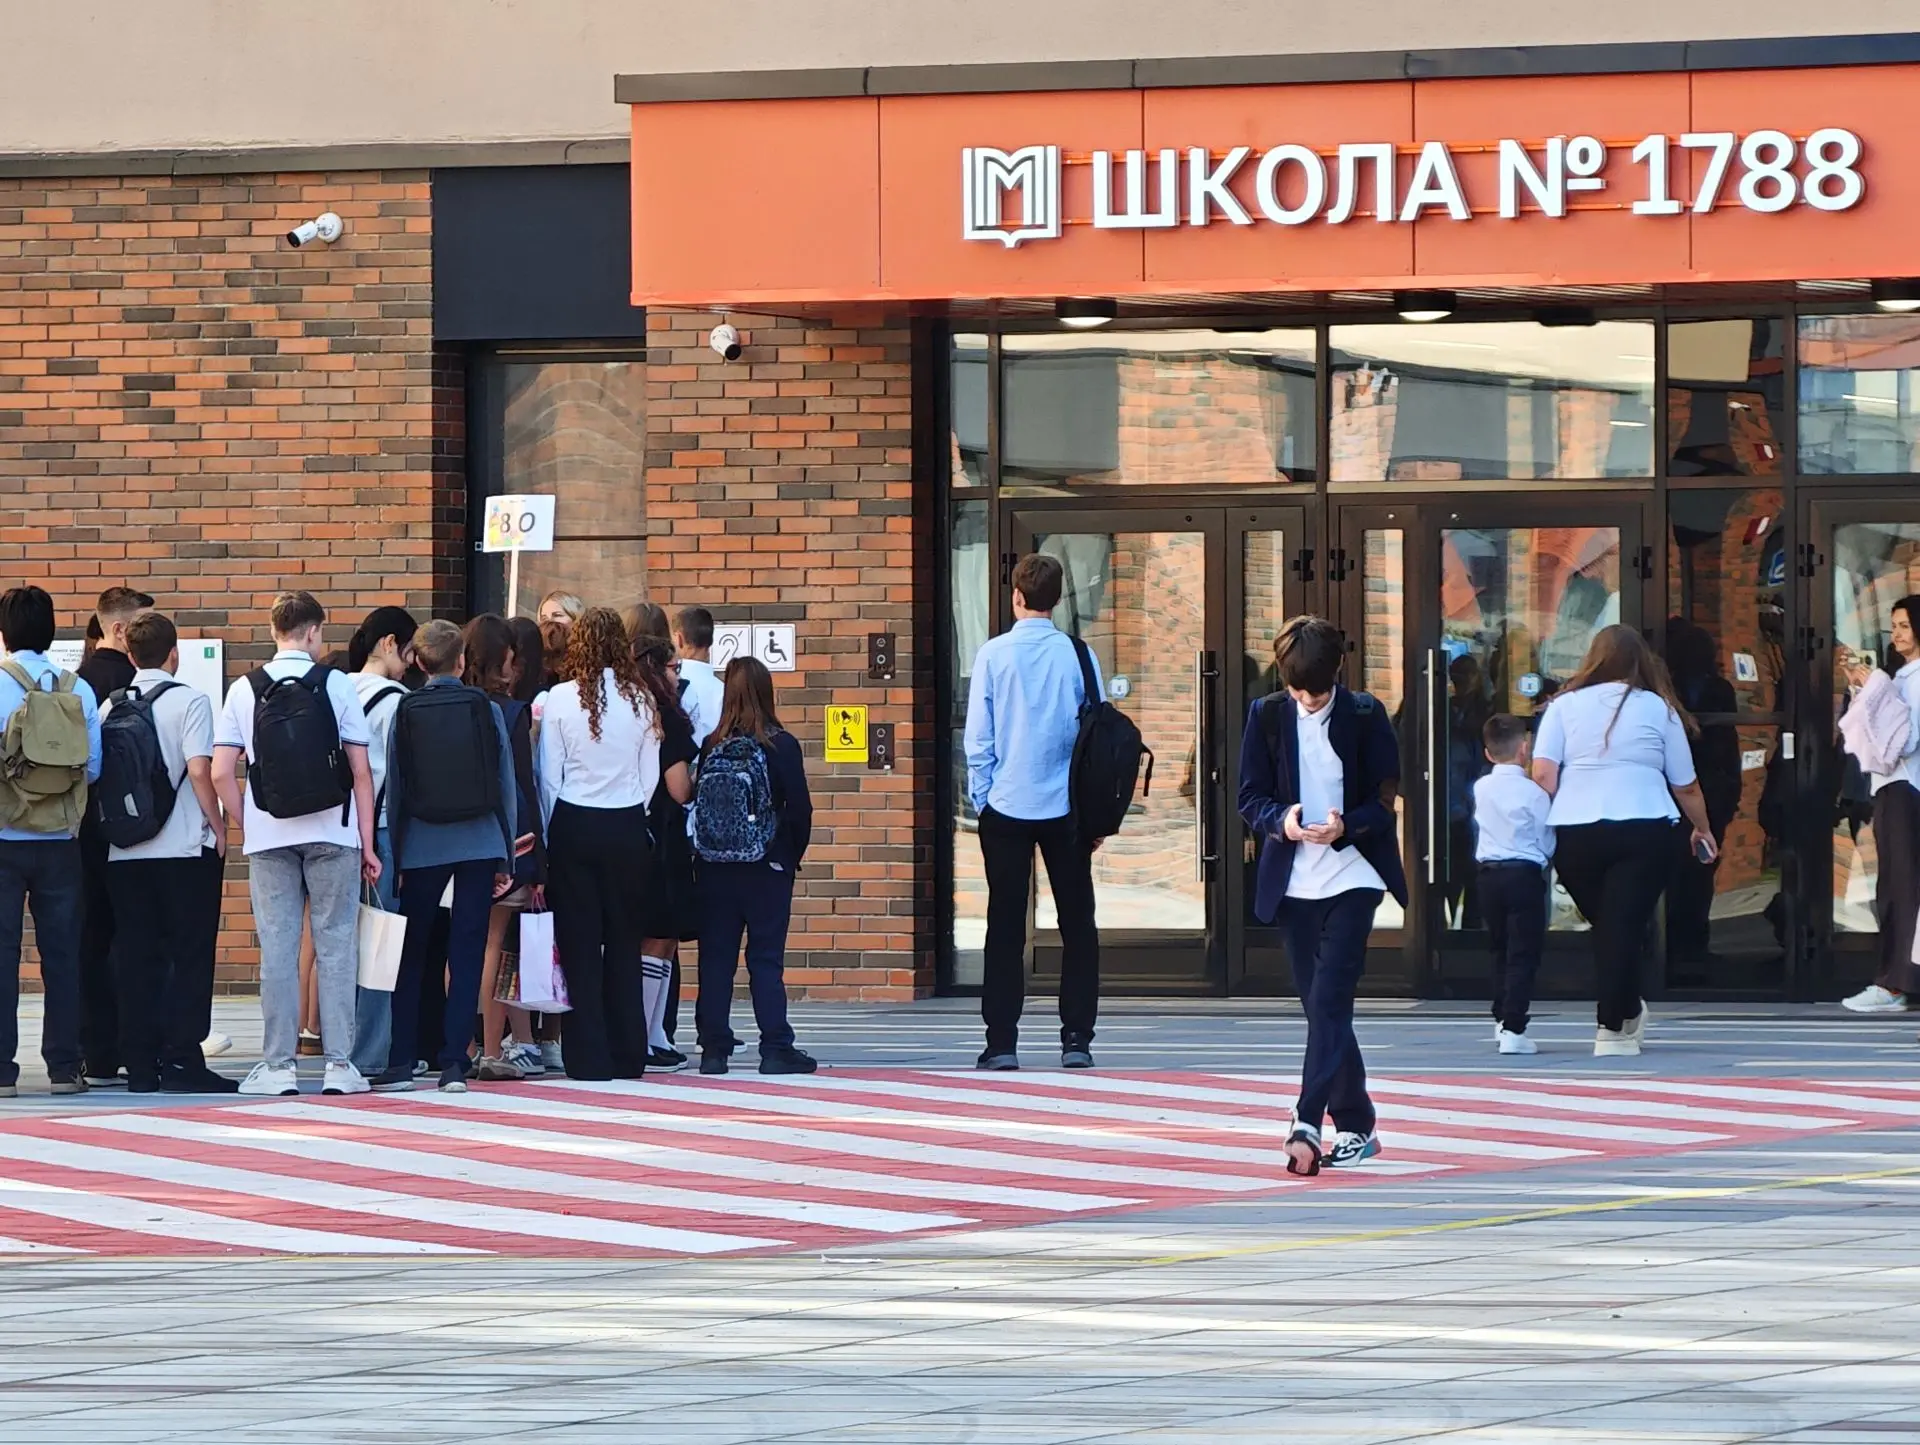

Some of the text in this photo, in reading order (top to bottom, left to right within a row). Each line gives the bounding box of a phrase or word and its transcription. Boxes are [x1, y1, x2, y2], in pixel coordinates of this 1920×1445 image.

[1092, 141, 1472, 229] ШКОЛА
[1499, 135, 1607, 218] №
[1632, 128, 1863, 216] 1788
